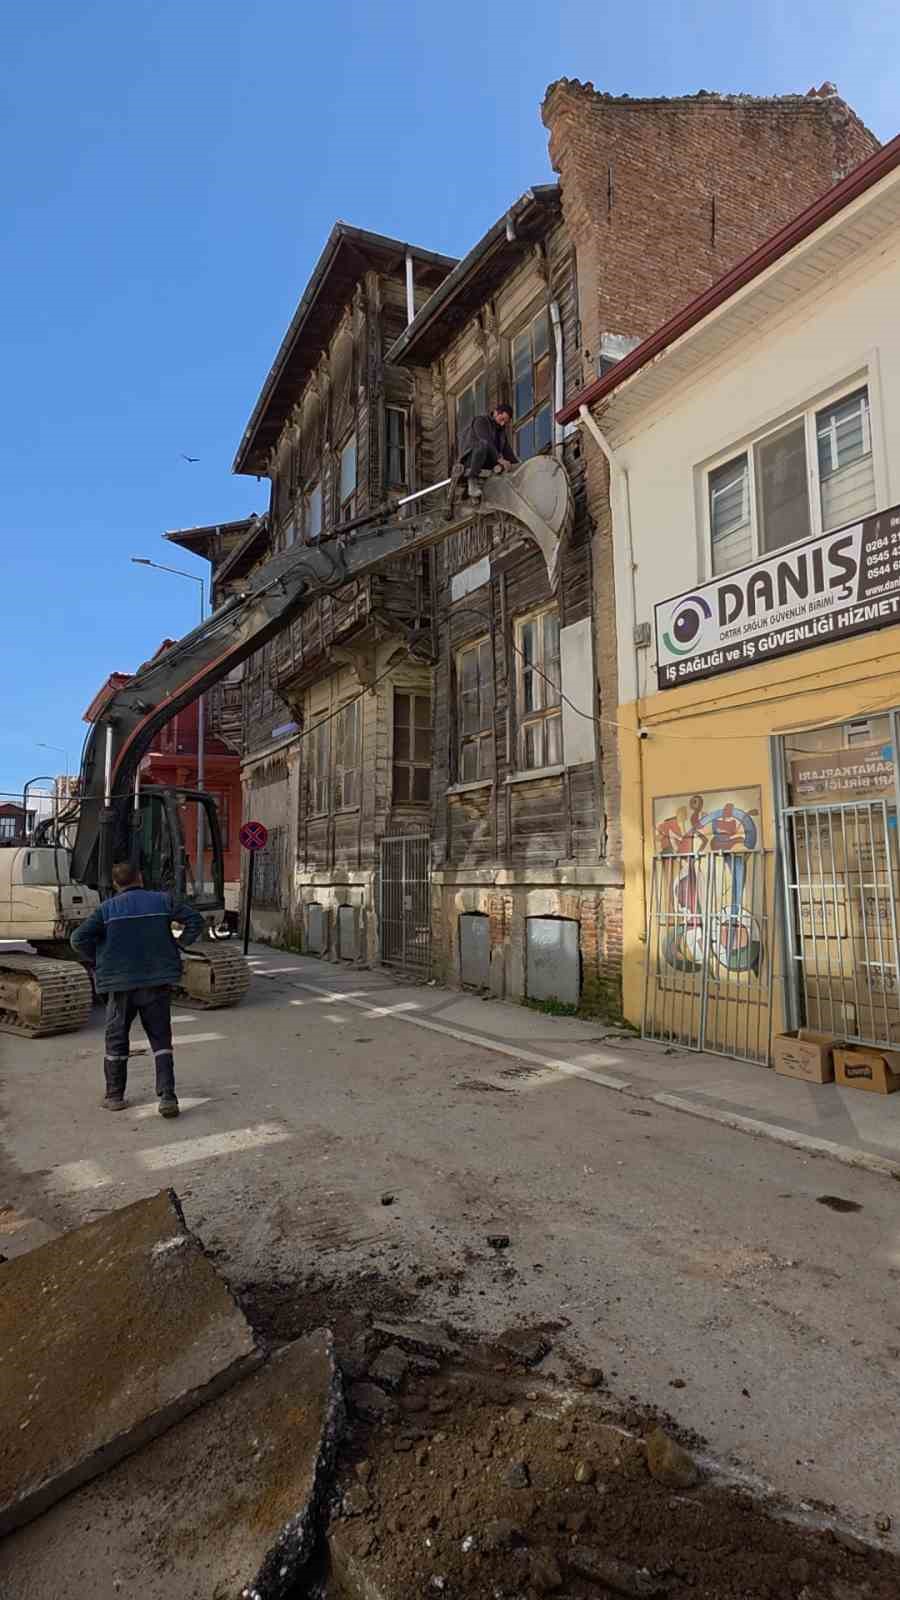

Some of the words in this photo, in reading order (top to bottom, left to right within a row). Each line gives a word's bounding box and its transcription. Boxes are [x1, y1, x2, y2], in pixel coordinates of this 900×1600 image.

[865, 536, 888, 552] 0284
[866, 550, 889, 566] 0545
[867, 563, 890, 579] 0544
[718, 535, 857, 627] DANIŞ
[666, 665, 677, 681] İŞ
[679, 649, 723, 675] SAĞLIĞI
[726, 650, 740, 660] ve
[743, 641, 755, 658] İŞ
[758, 615, 833, 651] GÜVENLİĞİ
